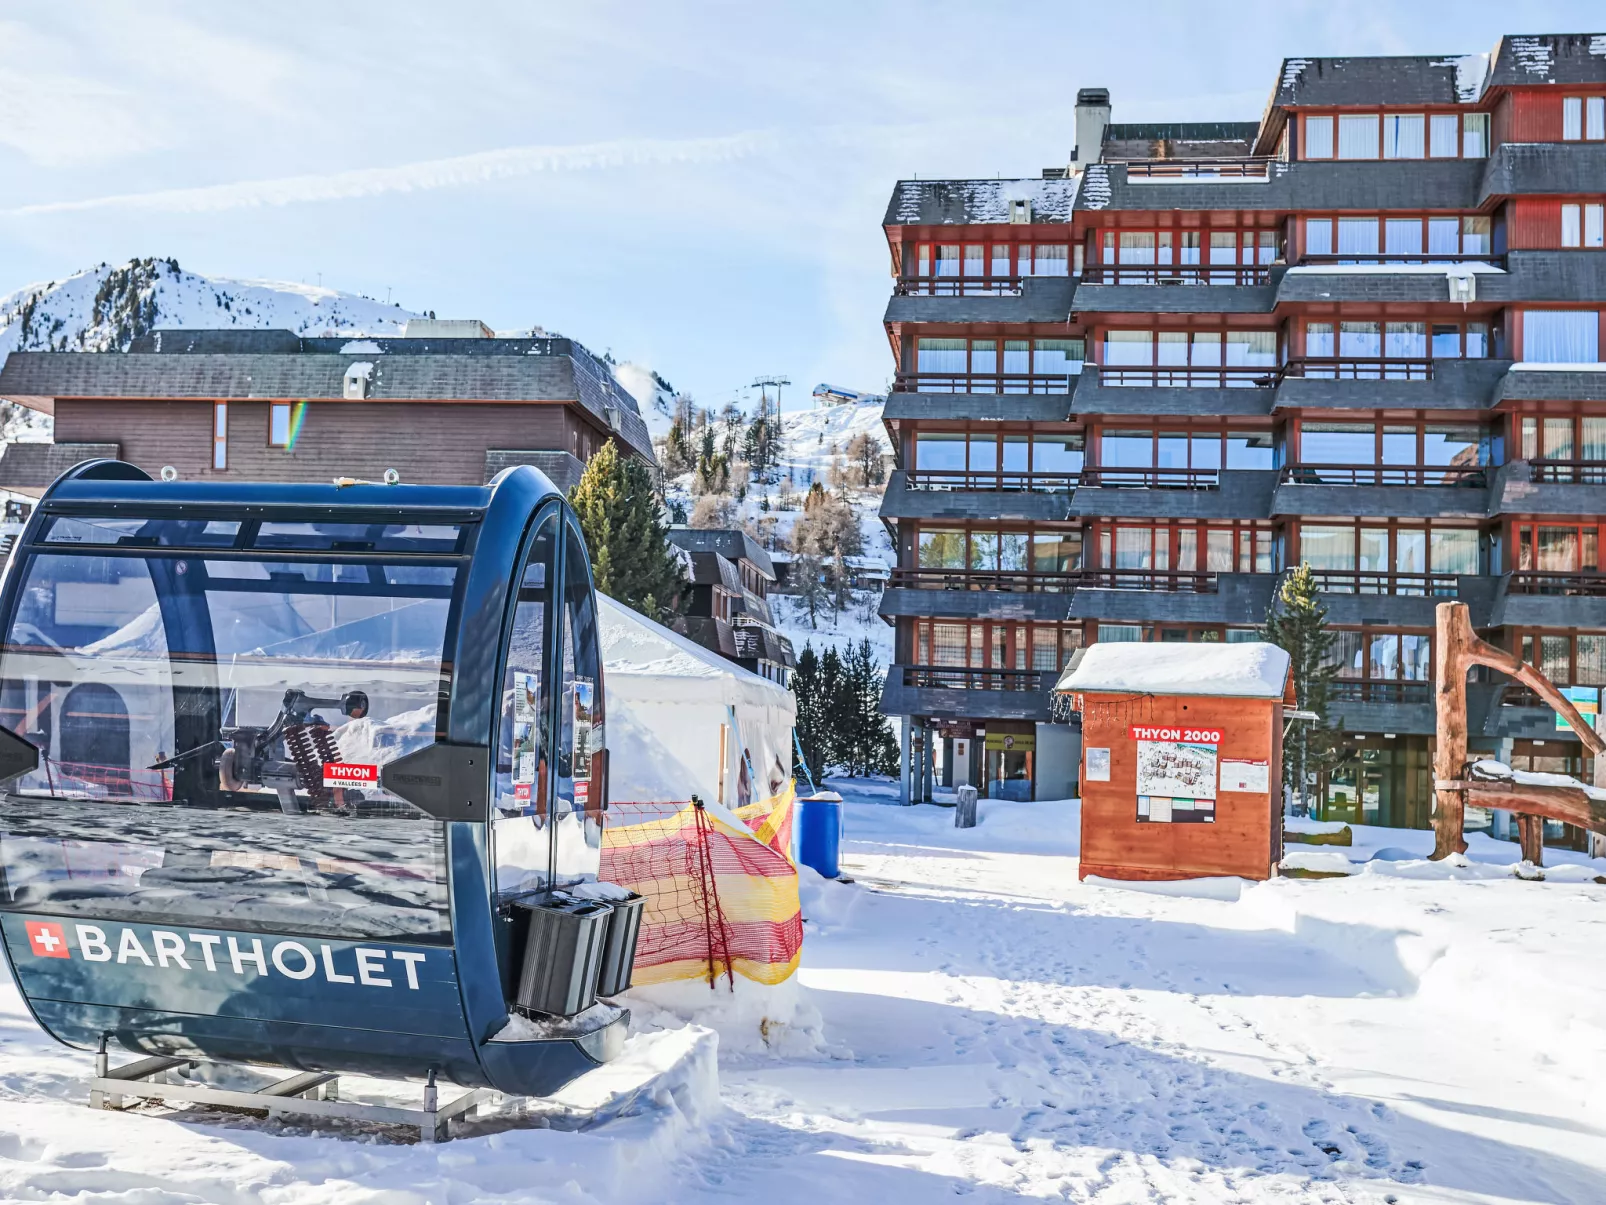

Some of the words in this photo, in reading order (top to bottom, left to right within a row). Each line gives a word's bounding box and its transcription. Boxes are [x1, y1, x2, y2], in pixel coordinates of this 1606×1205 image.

[1132, 727, 1180, 740] THYON
[1183, 730, 1220, 742] 2000
[330, 766, 370, 779] THYON
[74, 924, 426, 990] BARTHOLET
